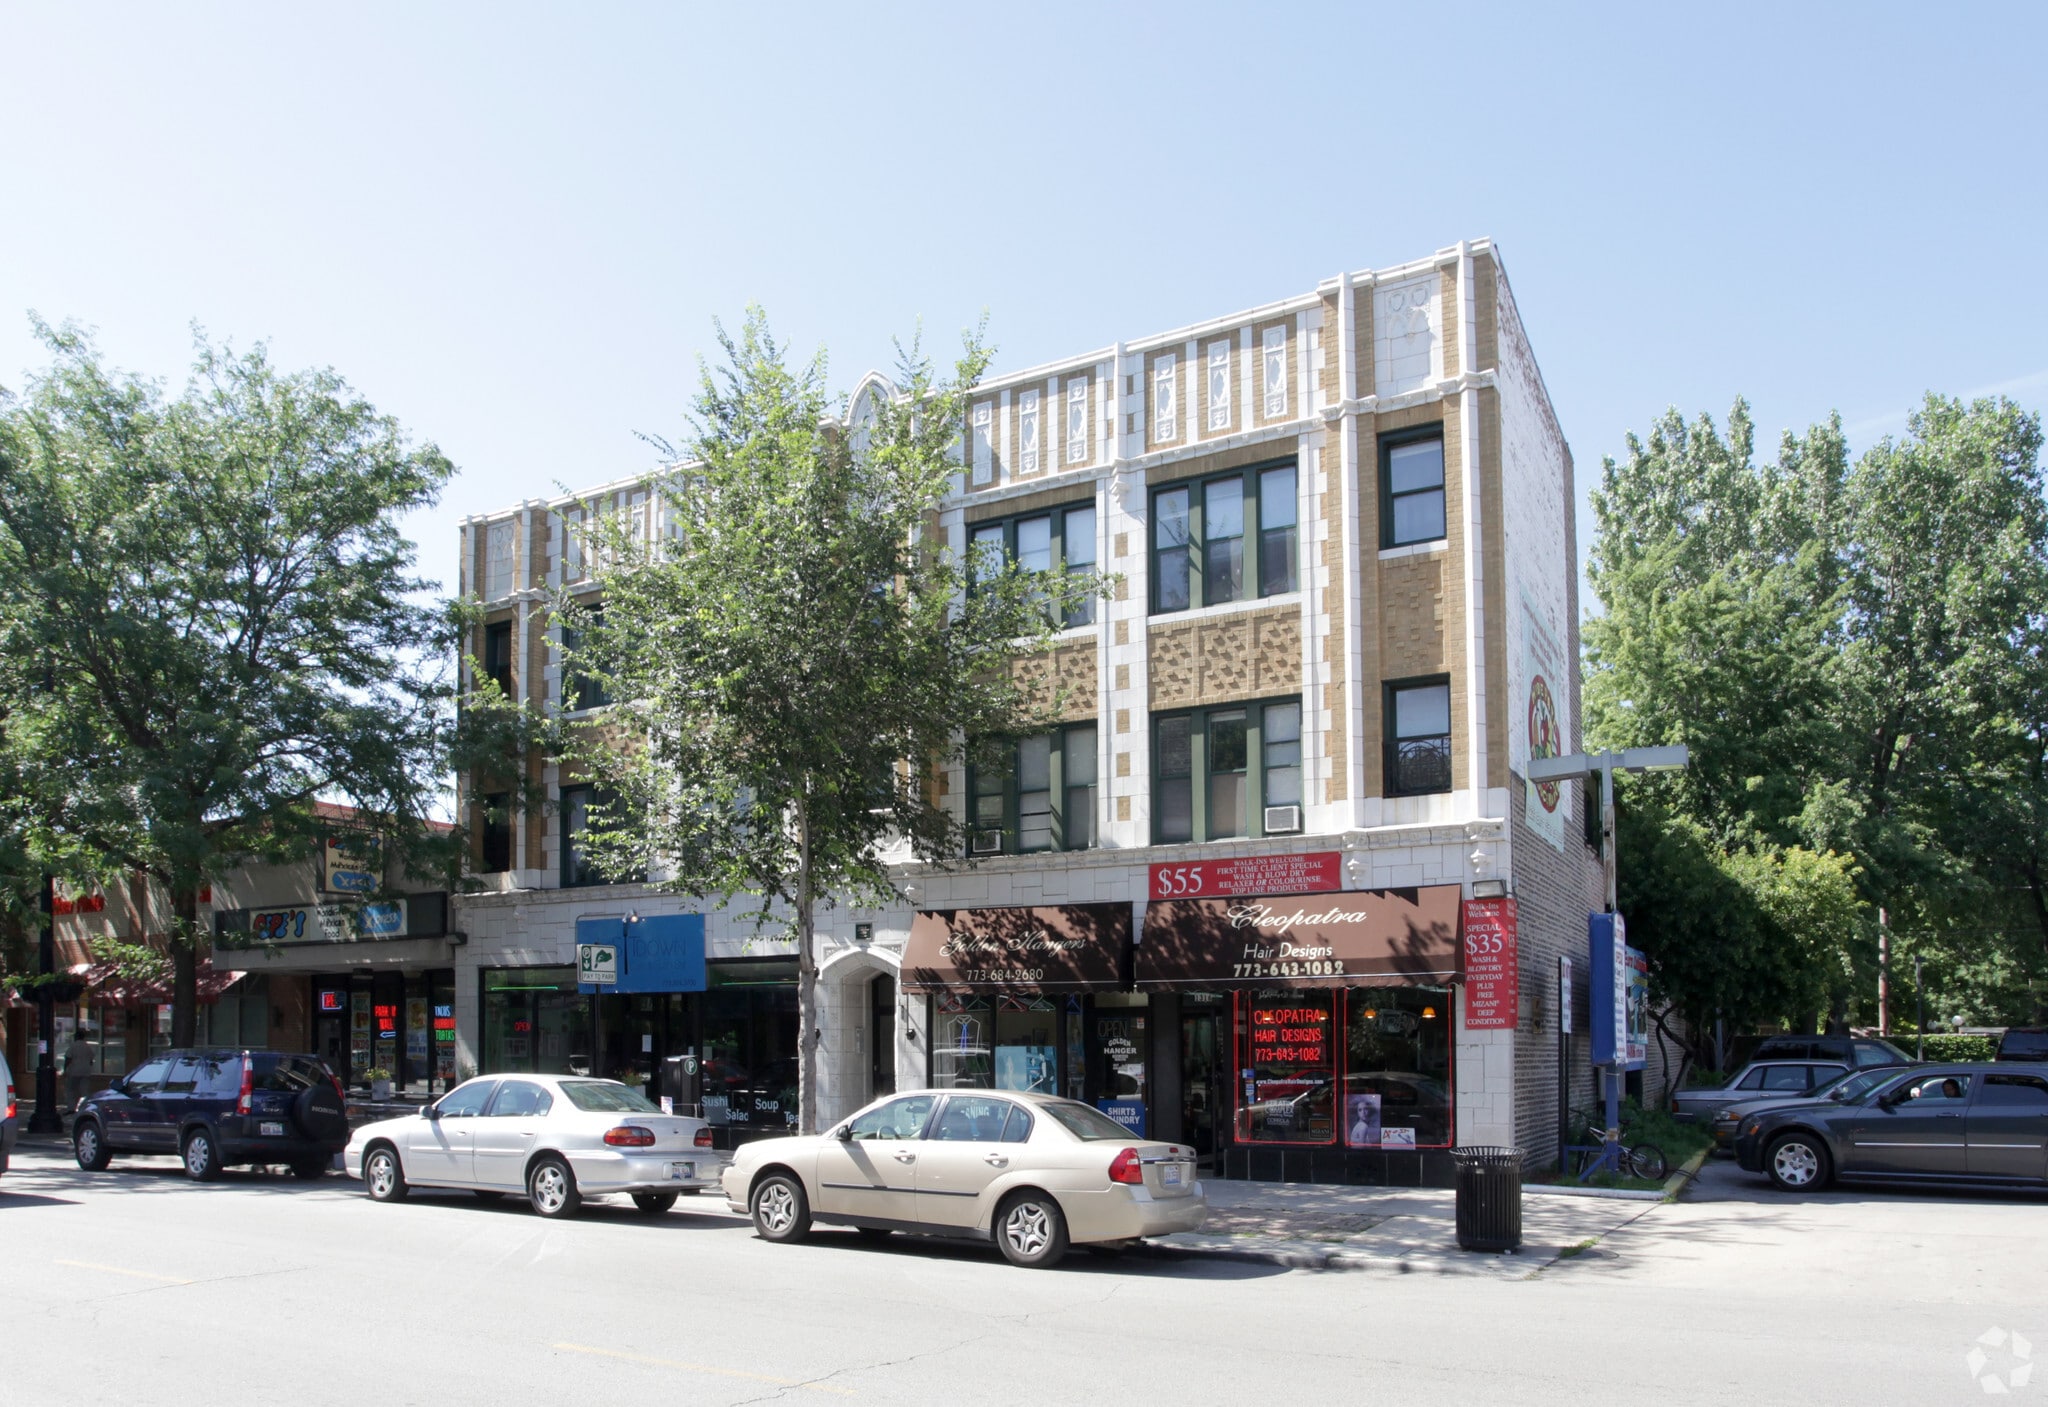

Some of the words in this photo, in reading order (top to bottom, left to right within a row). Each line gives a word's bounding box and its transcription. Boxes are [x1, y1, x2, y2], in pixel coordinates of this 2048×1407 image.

[1269, 856, 1304, 864] WELCOME
[1217, 867, 1237, 875] FIRST
[1240, 865, 1258, 873] TIME
[1260, 863, 1288, 872] CLIENT
[1290, 861, 1323, 870] SPECIAL
[1290, 869, 1306, 877] DRY
[1158, 867, 1203, 897] $55
[1218, 880, 1254, 889] RELAXER
[1267, 883, 1309, 892] PRODUCTS
[1227, 904, 1367, 934] Cleopatra
[1467, 924, 1501, 932] SPECIAL
[939, 932, 1000, 957] Golden
[1006, 930, 1086, 957] Hangers
[1466, 933, 1503, 956] $35
[1243, 943, 1274, 959] Hair
[1279, 942, 1333, 959] Designs
[966, 968, 1044, 981] 773-684-2680
[1233, 961, 1344, 977] 773-643-1082
[1467, 973, 1504, 981] EVERYDAY
[1254, 1009, 1321, 1025] CLEOPATRA
[1255, 1030, 1276, 1042] HAIR
[1281, 1028, 1322, 1042] DESIGNS
[1108, 1038, 1131, 1046] GOLDEN
[1104, 1047, 1137, 1055] HANGER
[1255, 1047, 1320, 1062] 773-643-1082
[702, 1095, 728, 1107] Sushi
[755, 1099, 779, 1112] Soup
[1107, 1107, 1136, 1116] SHIRTS
